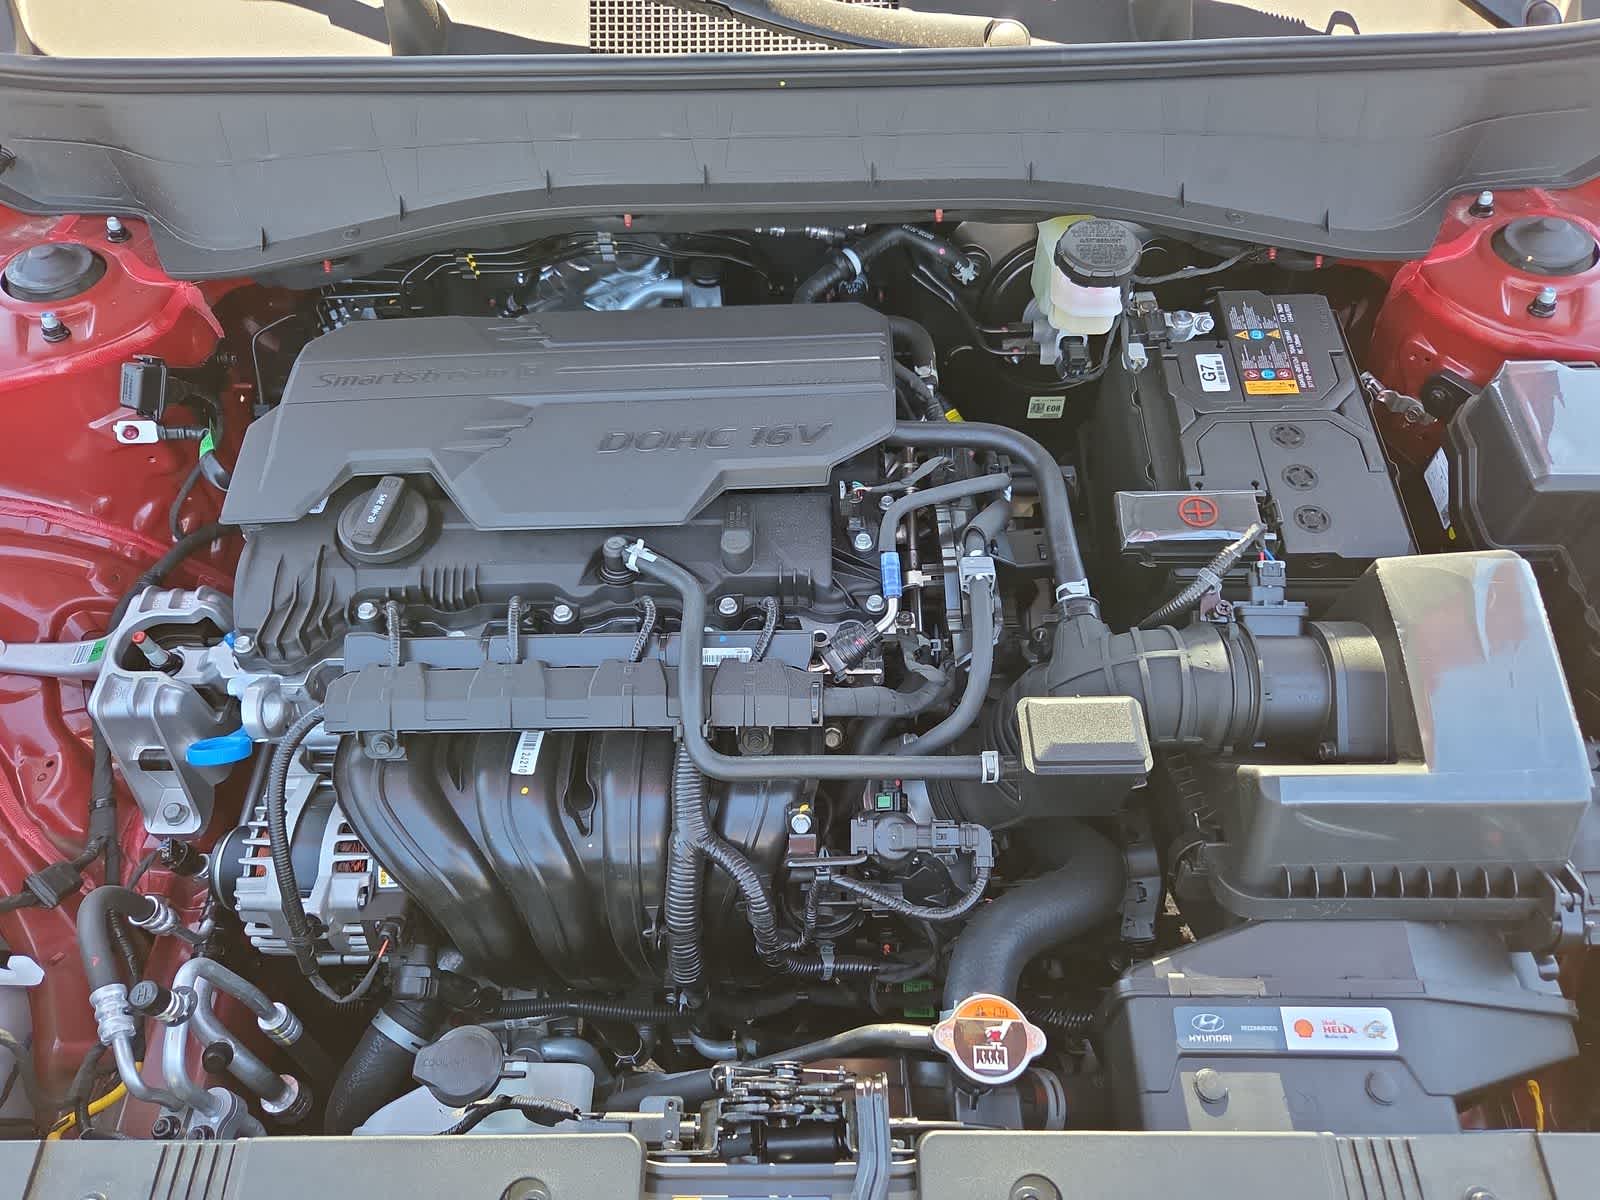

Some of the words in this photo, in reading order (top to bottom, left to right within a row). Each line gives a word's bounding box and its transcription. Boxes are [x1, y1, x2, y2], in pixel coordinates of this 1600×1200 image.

[1200, 364, 1217, 382] G7
[598, 427, 737, 453] DOHC
[750, 423, 833, 449] 16V
[1188, 1034, 1233, 1043] HYUNDAI
